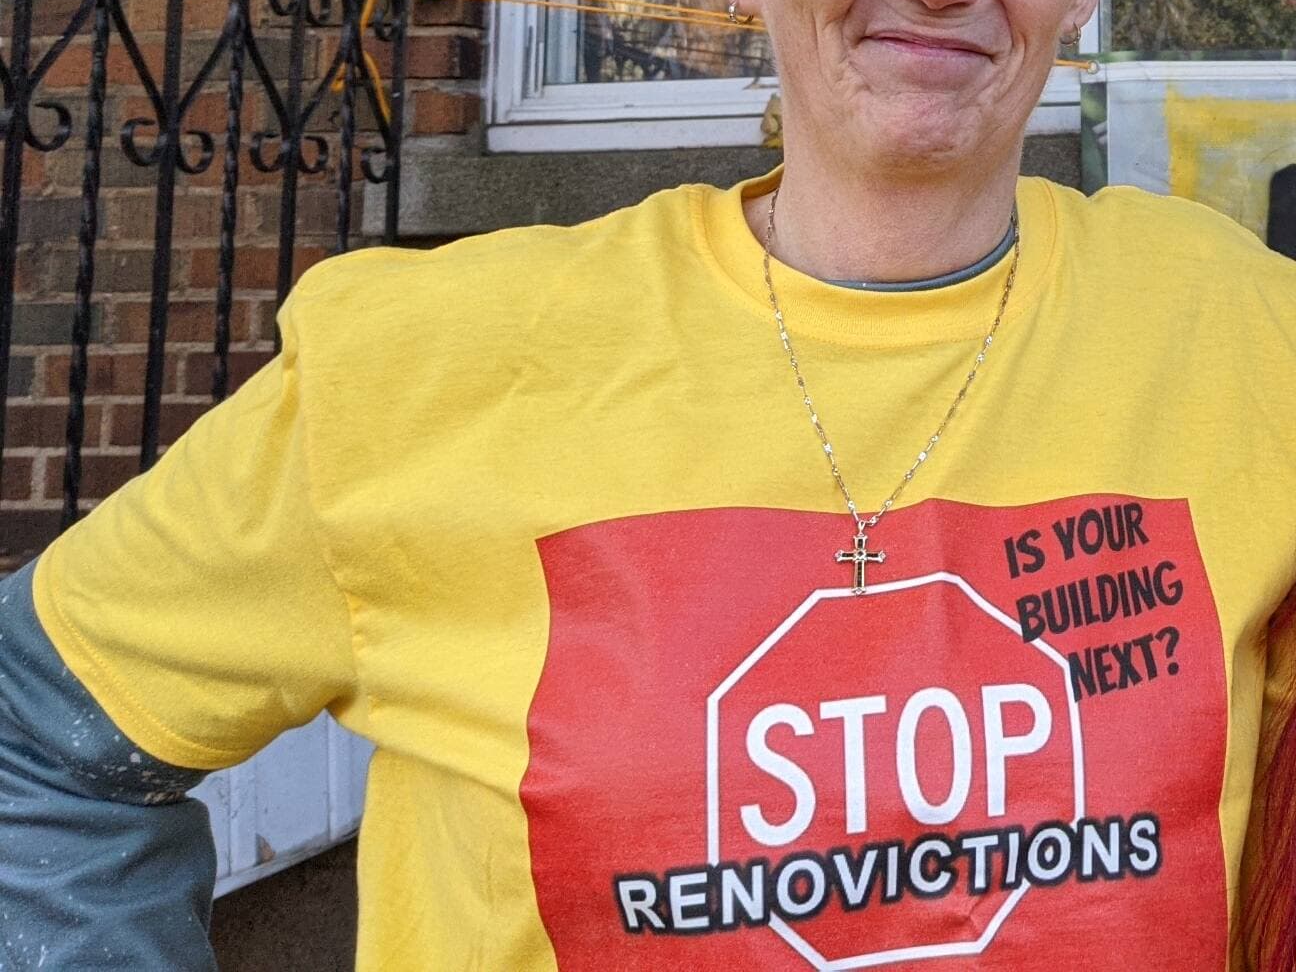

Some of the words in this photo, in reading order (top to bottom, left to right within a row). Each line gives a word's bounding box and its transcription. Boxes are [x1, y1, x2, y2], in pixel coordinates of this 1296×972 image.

[1004, 529, 1045, 579] IS
[1052, 502, 1150, 561] YOUR
[1016, 561, 1183, 644] BUILDING
[1067, 625, 1180, 703] NEXT?
[740, 683, 1053, 848] STOP
[614, 817, 1162, 933] RENOVICTIONS
